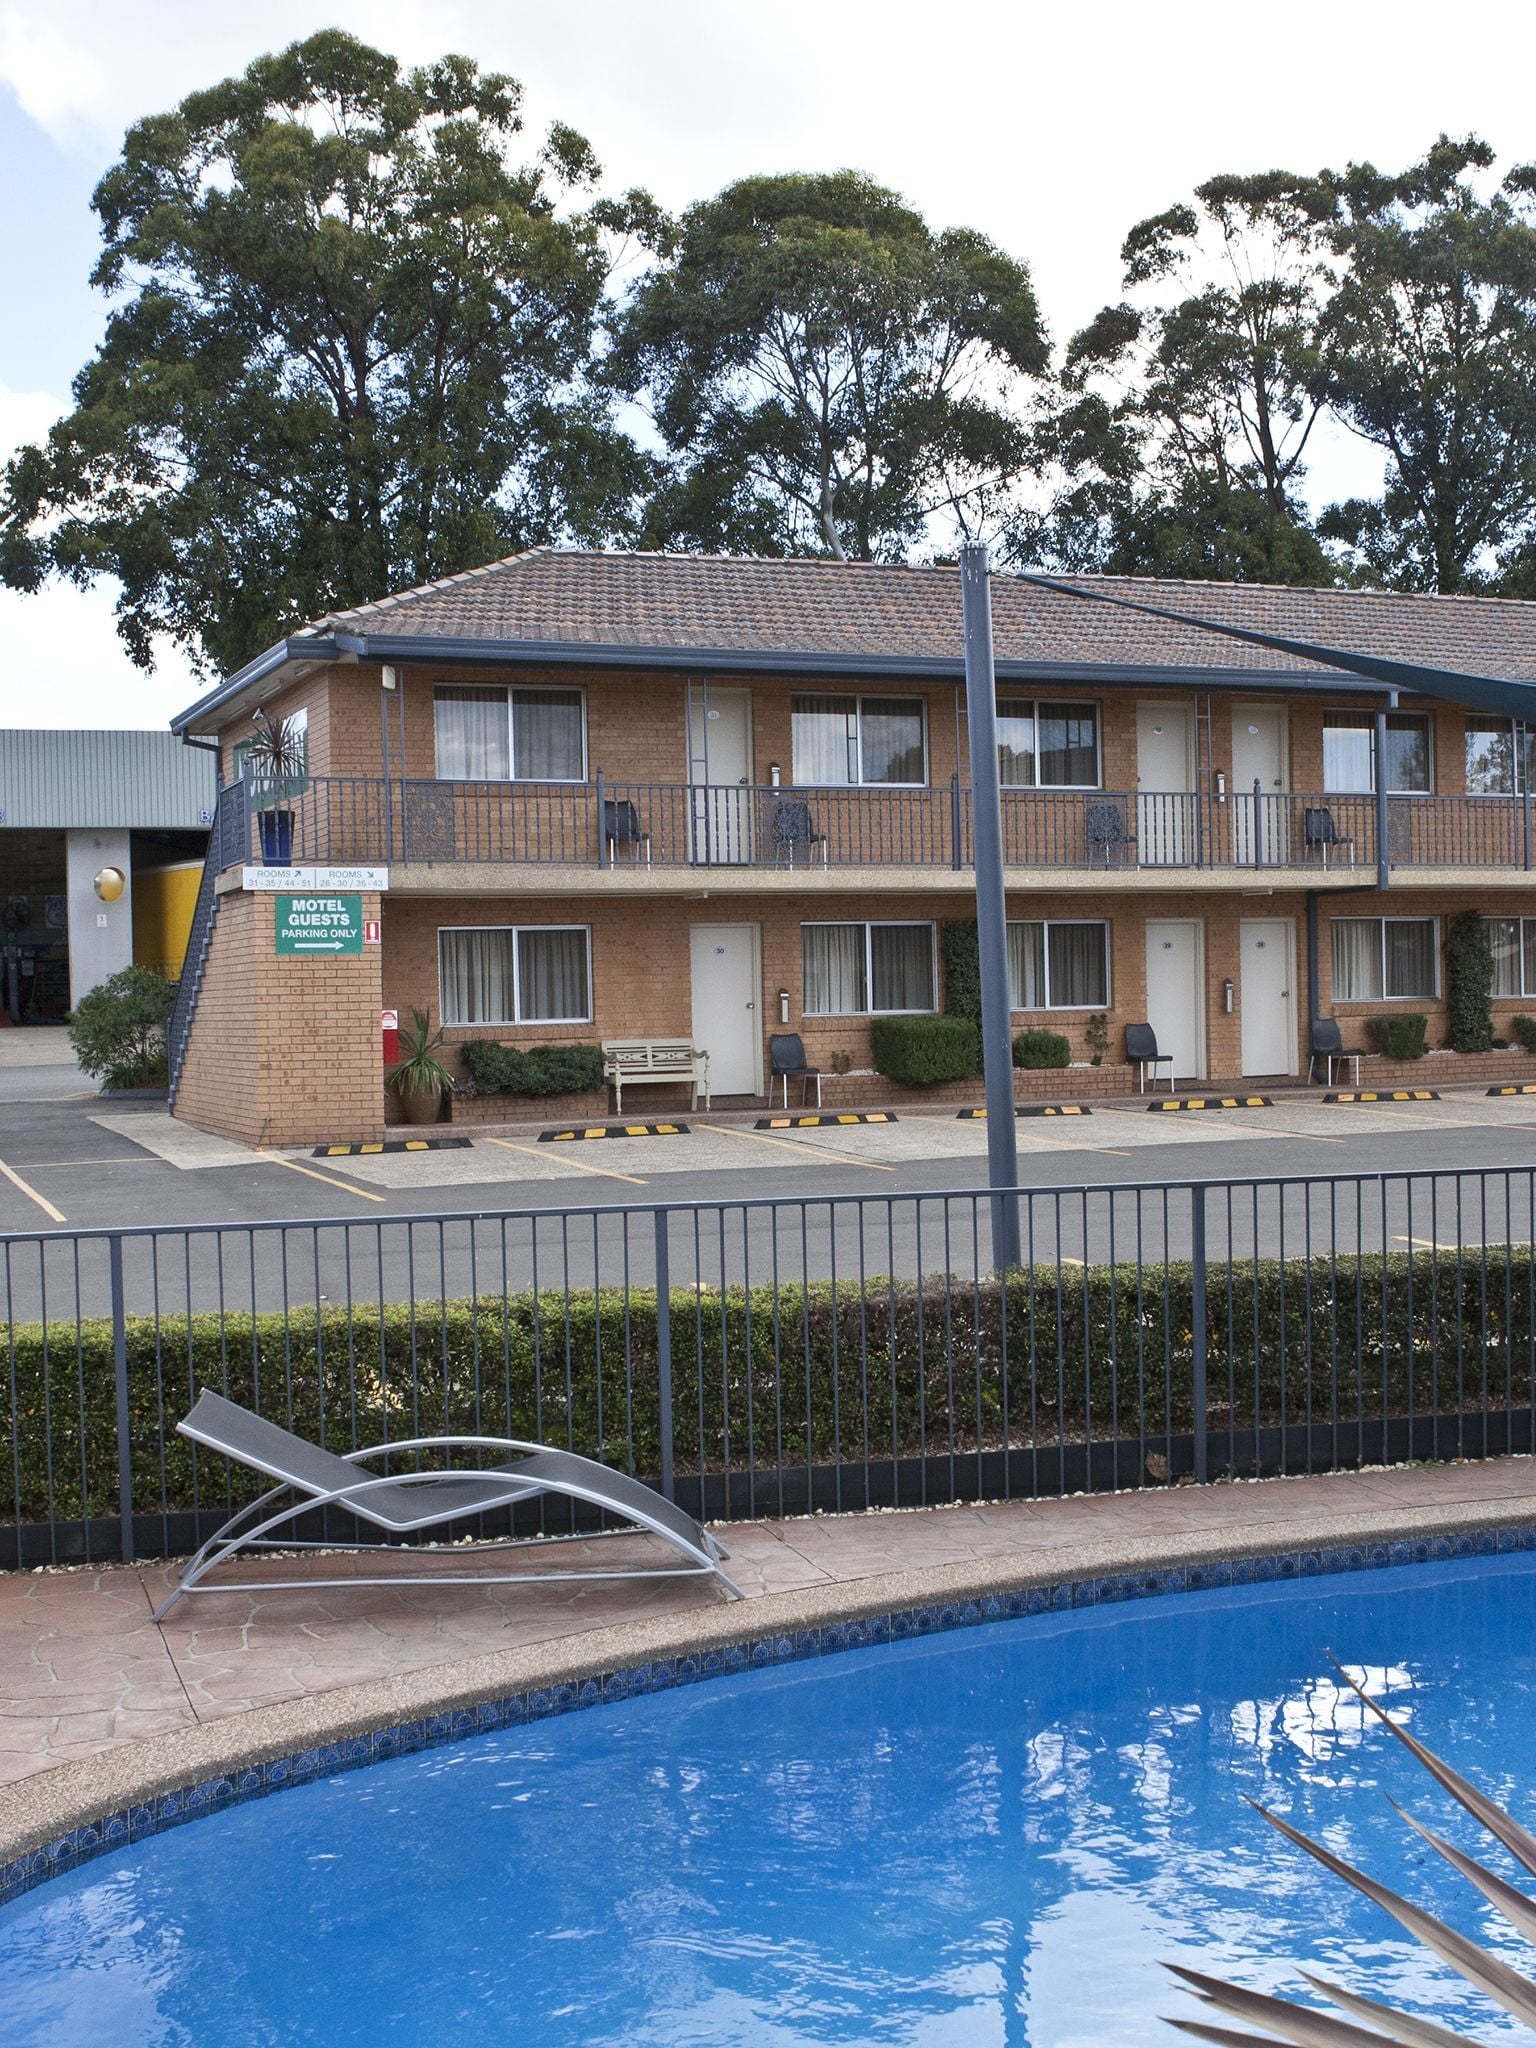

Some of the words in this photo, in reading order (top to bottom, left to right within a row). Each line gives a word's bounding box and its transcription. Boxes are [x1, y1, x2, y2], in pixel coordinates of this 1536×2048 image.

[257, 870, 291, 878] ROOMS
[329, 870, 362, 878] ROOMS
[292, 899, 346, 912] MOTEL
[288, 913, 351, 926] GUESTS
[281, 929, 328, 938] PARKING
[330, 929, 358, 938] ONLY
